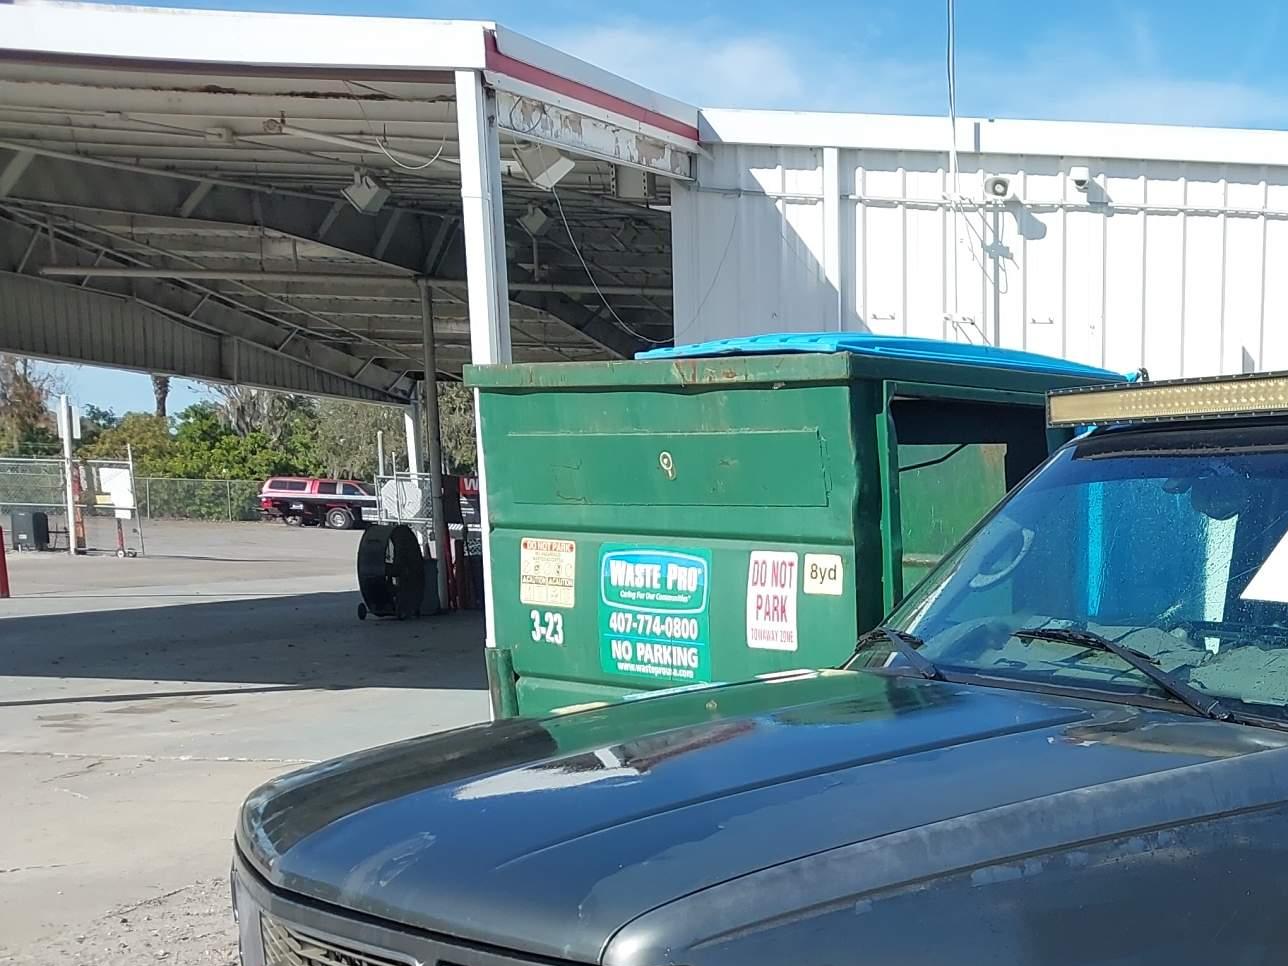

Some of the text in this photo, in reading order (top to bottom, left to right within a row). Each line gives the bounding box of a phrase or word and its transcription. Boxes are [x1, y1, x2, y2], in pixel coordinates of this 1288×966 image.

[609, 559, 698, 592] WASTE PRO
[752, 560, 795, 589] DO NOT
[810, 563, 837, 584] 8yd
[756, 594, 788, 623] PARK
[530, 609, 564, 645] 3-23
[609, 612, 698, 640] 407-774-0800
[611, 639, 699, 668] NO PARKING
